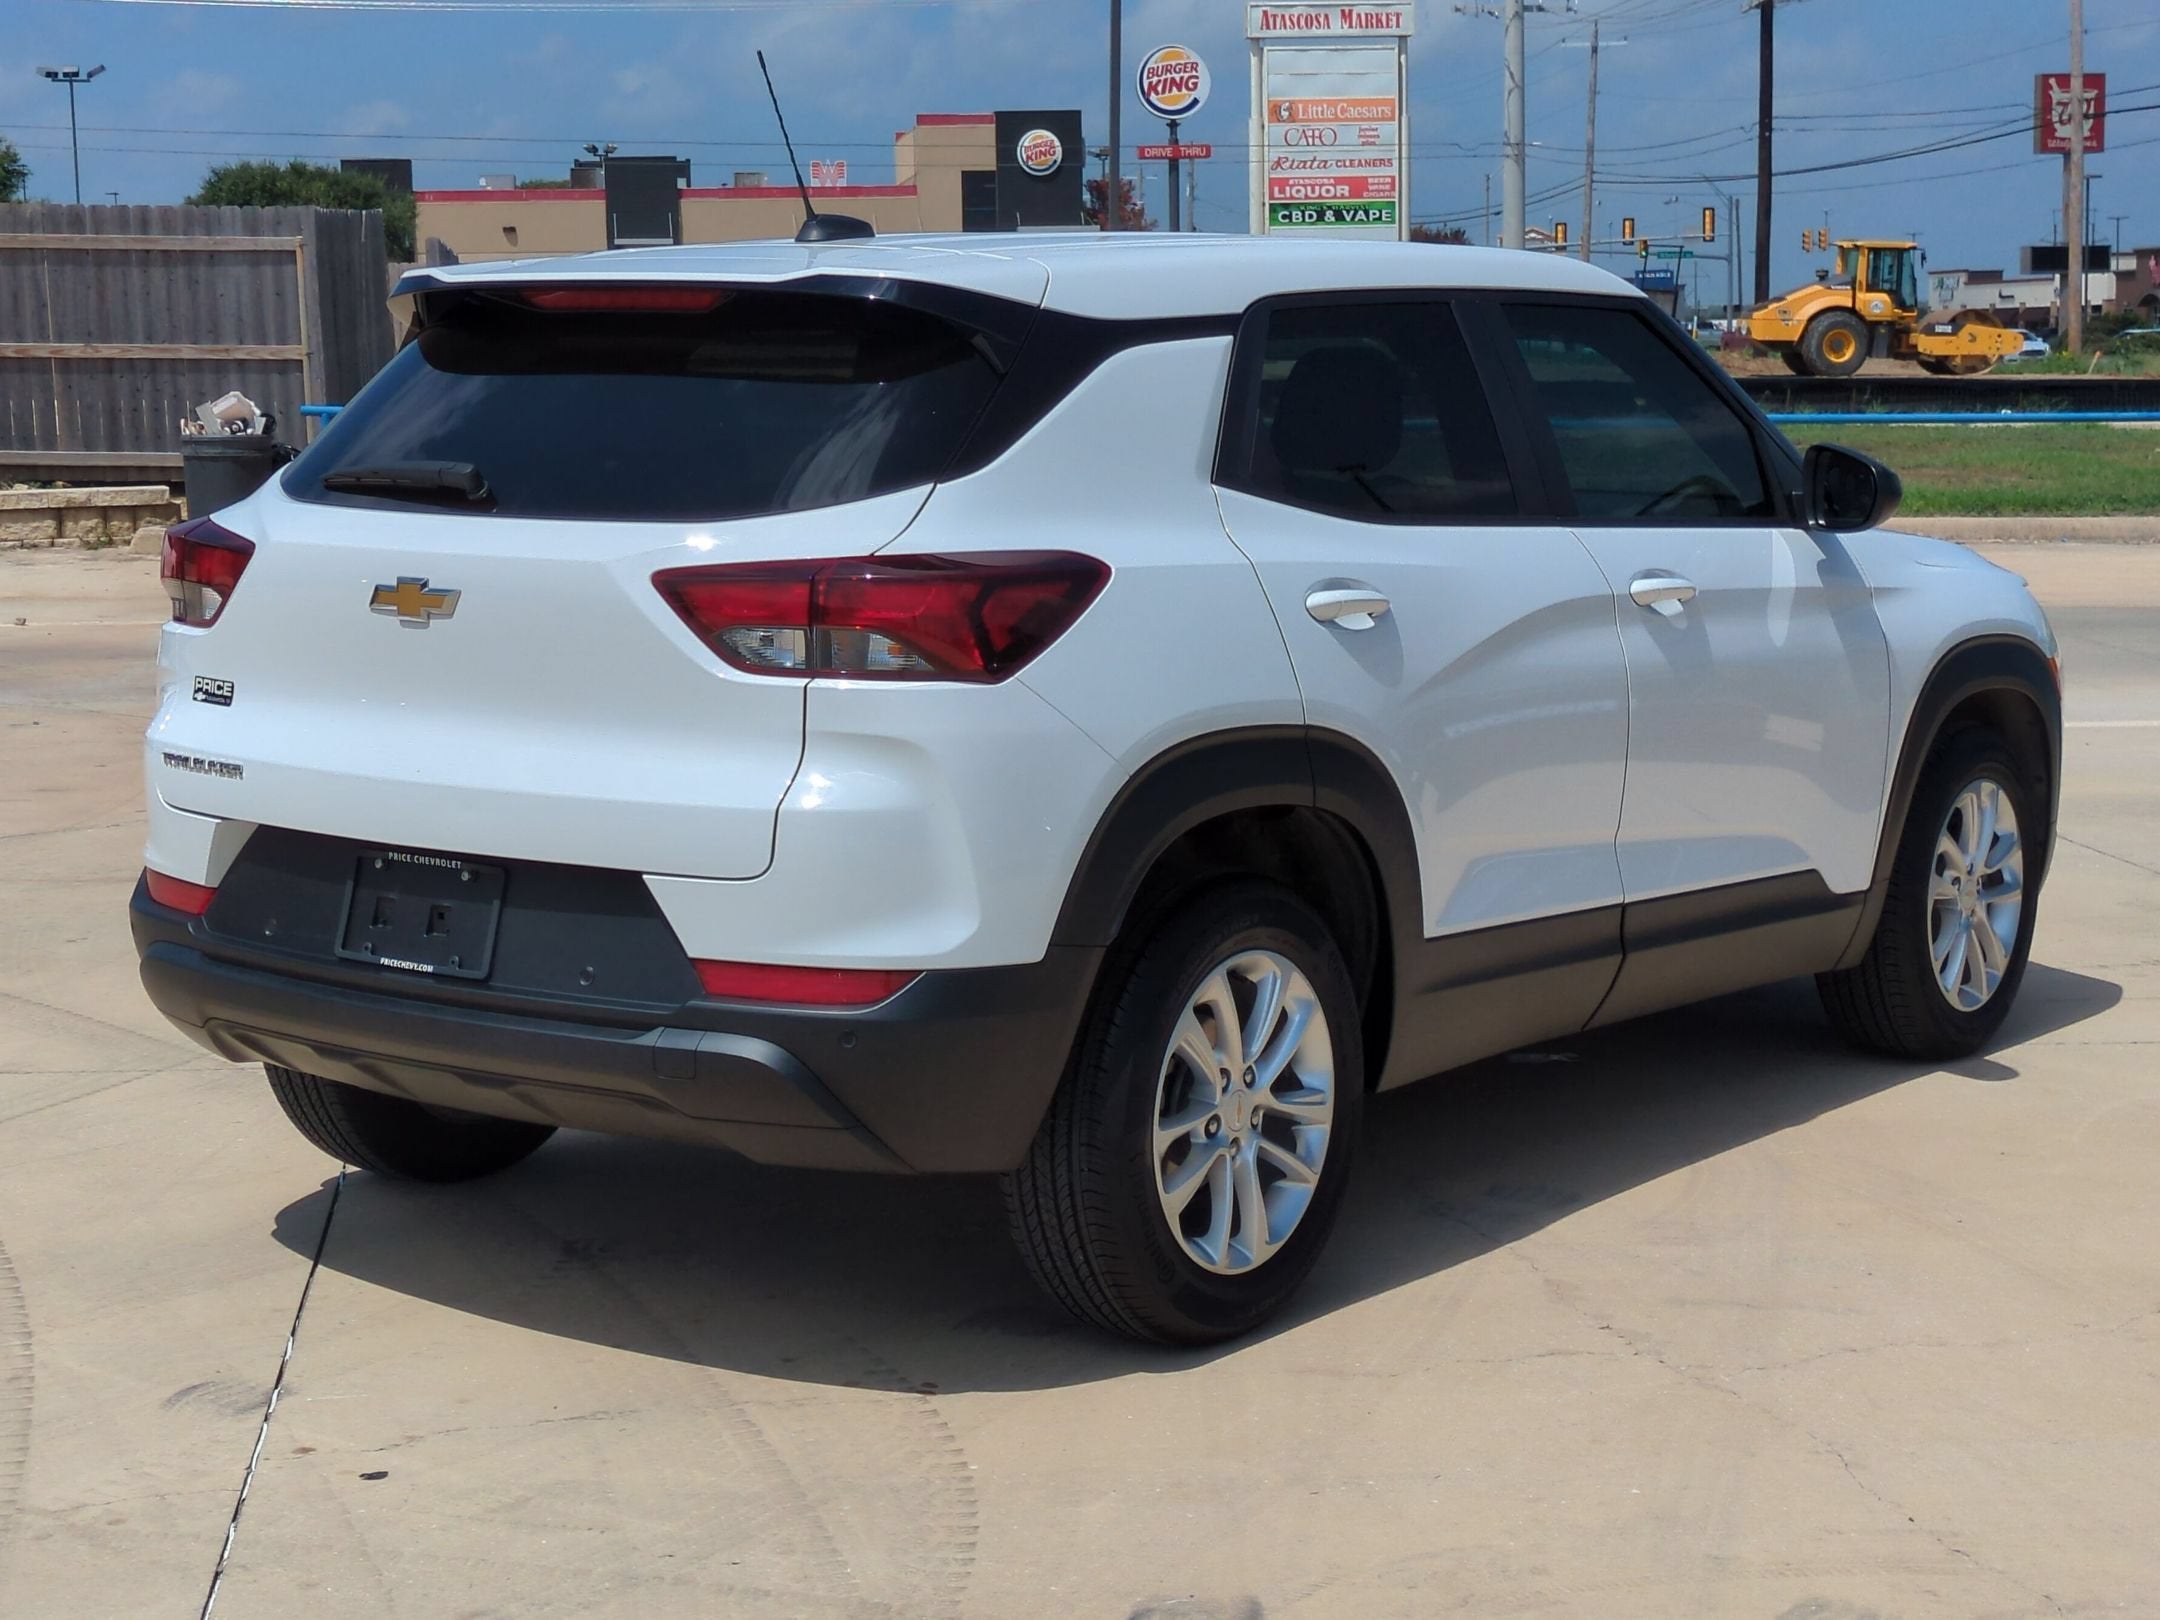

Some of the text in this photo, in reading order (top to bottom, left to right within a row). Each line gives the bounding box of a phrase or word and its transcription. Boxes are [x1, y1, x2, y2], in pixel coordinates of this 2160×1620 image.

[1146, 61, 1200, 80] BURGER
[1146, 74, 1200, 99] KING
[1298, 103, 1392, 119] Little Caesars
[1284, 126, 1338, 147] CATO
[1025, 147, 1057, 164] KING
[1144, 146, 1207, 158] DRIVE THRU
[1271, 156, 1393, 171] Riata CLEANERS
[1273, 185, 1350, 199] LIQUOR
[1278, 209, 1392, 223] CBD & VAPE
[195, 677, 232, 696] PRICE
[388, 852, 462, 870] PRICE CHEVROLET
